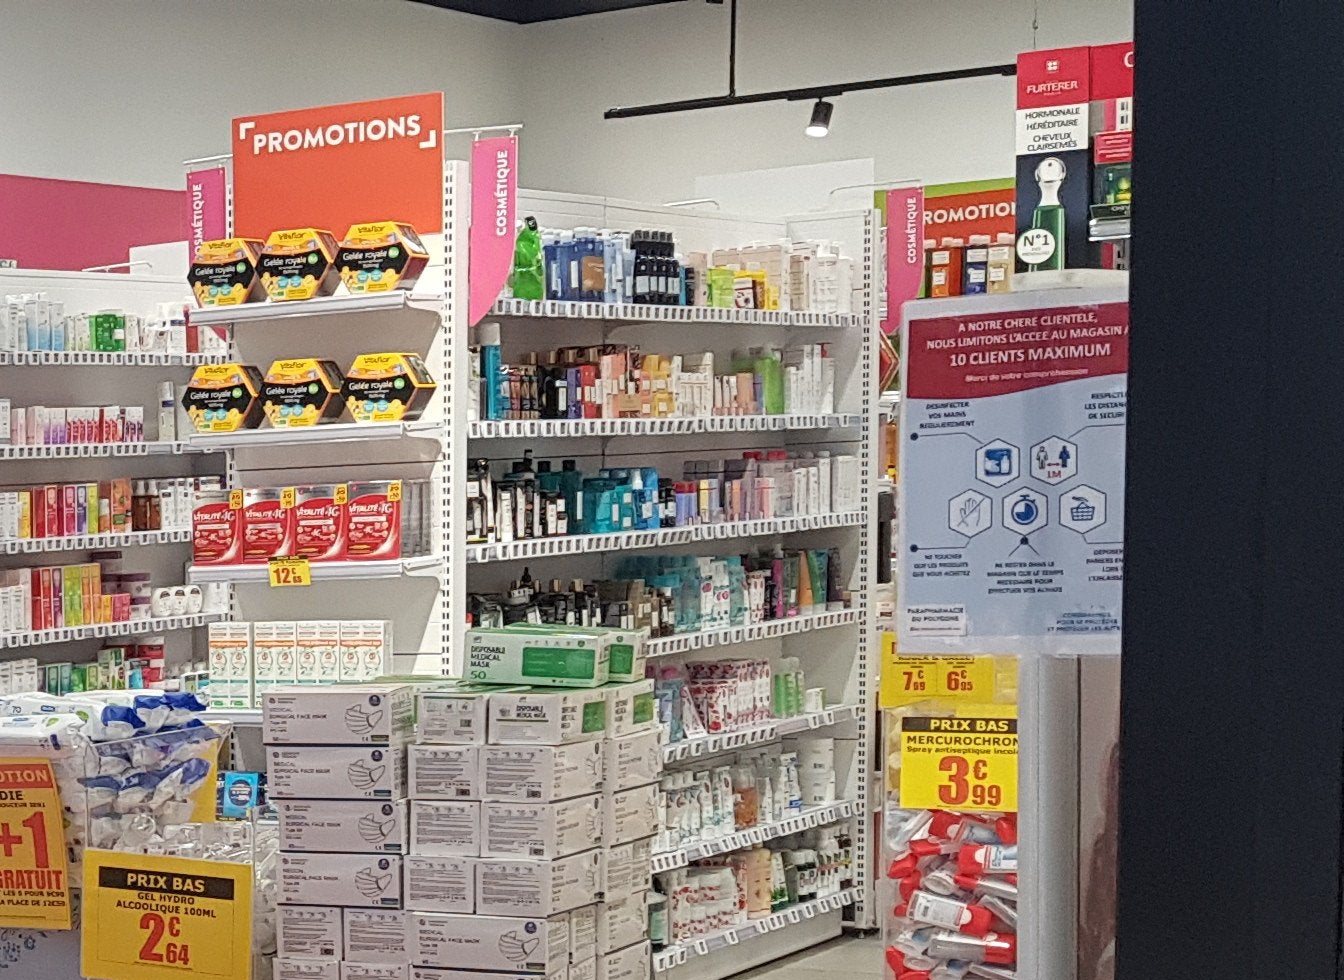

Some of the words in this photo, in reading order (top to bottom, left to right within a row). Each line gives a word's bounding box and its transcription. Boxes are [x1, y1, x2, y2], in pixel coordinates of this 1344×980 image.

[1026, 80, 1079, 94] FURTERER
[1025, 107, 1080, 119] HORMONALE
[254, 114, 421, 155] PROMOTIONS
[496, 150, 509, 236] COSMÉTIQUE
[192, 183, 204, 261] OSMÉTIQUE
[923, 202, 1015, 224] ROMOTIO
[907, 197, 917, 264] COSMÉTIQUE
[1023, 233, 1050, 248] N°1
[958, 323, 966, 332] A
[968, 319, 1002, 331] NOTRE
[1004, 317, 1038, 329] CHERE
[926, 339, 956, 350] NOUS
[957, 335, 1007, 347] LIMITONS
[1051, 328, 1067, 340] AU
[1070, 325, 1122, 338] MAGASIN
[950, 354, 966, 367] 10
[969, 347, 1025, 365] CLIENTS
[1027, 343, 1111, 361] MAXIMUM
[274, 567, 290, 584] 12
[469, 660, 491, 668] MASK
[470, 653, 501, 661] MEDICAL
[470, 670, 487, 680] 50
[903, 671, 913, 691] 7
[947, 671, 959, 691] 6
[930, 719, 970, 731] PRIX
[976, 719, 1009, 732] BAS
[907, 735, 1018, 747] MERCUROCHRO
[973, 759, 988, 780] €
[938, 755, 969, 805] 3
[972, 784, 1001, 806] 99
[127, 872, 168, 889] PRIX
[172, 877, 206, 893] BAS
[116, 899, 181, 914] ALCOOLIQUE
[183, 906, 217, 918] 100ML
[137, 892, 156, 901] GEL
[159, 894, 195, 905] HYDRO
[139, 912, 165, 962] 2
[165, 942, 190, 965] 64
